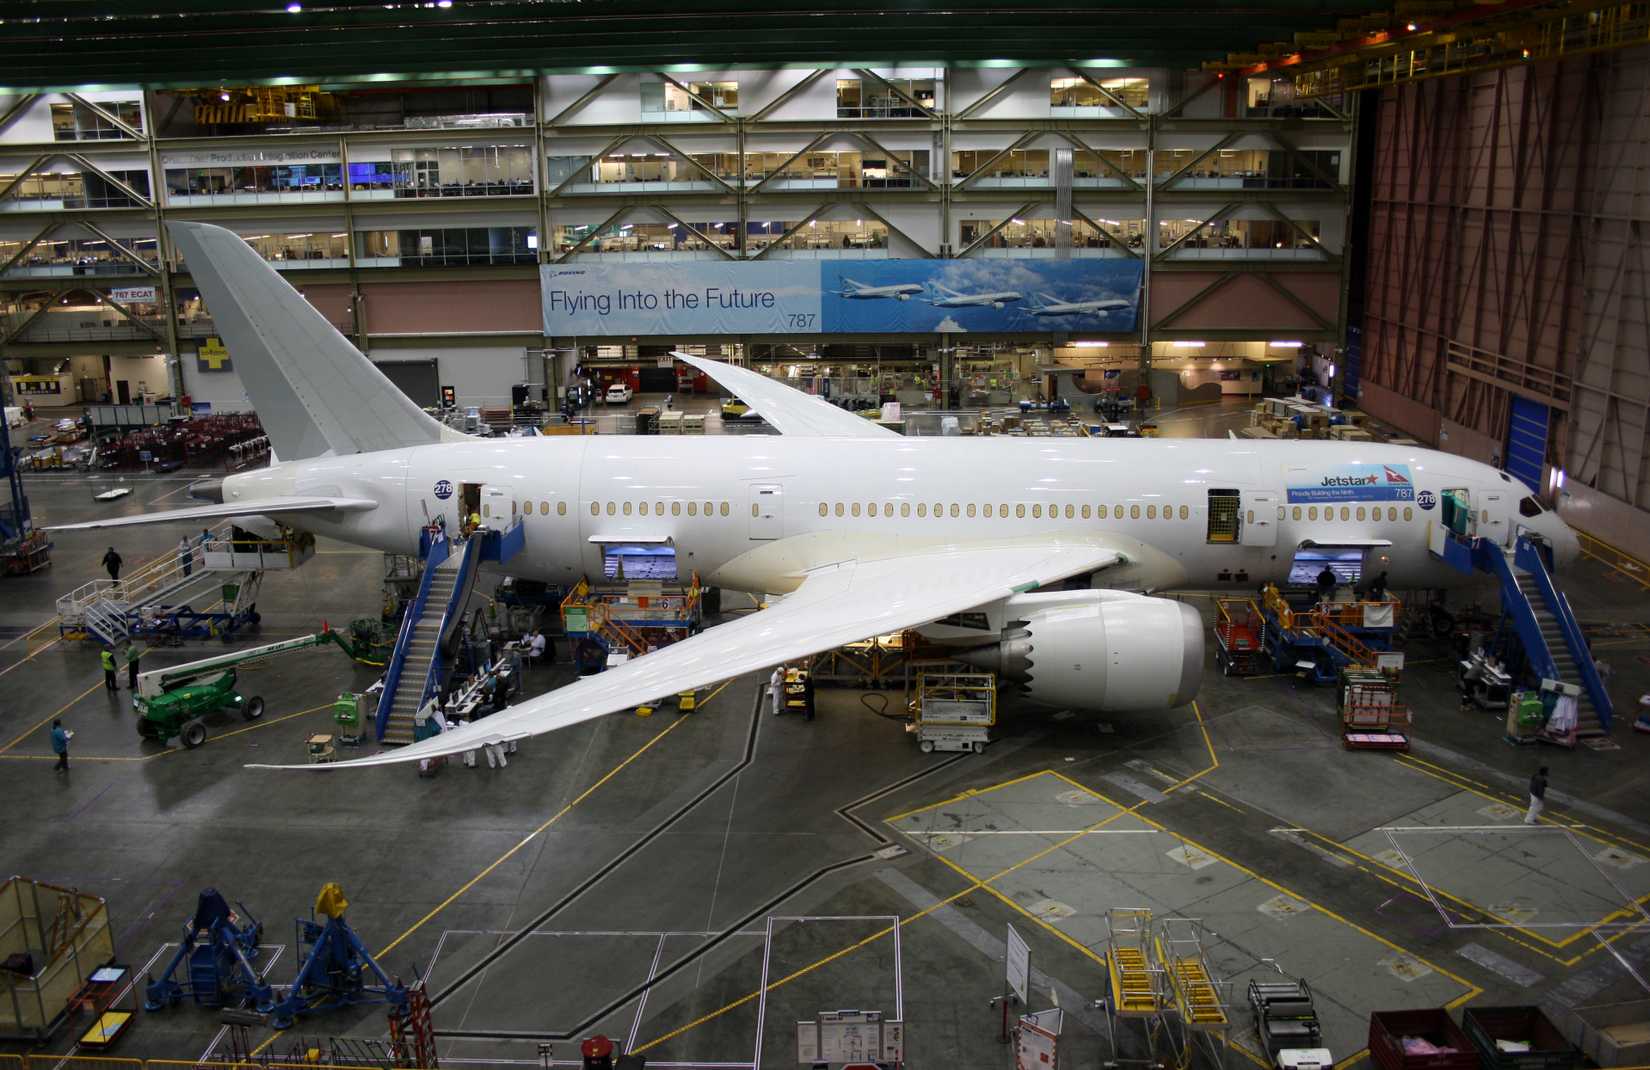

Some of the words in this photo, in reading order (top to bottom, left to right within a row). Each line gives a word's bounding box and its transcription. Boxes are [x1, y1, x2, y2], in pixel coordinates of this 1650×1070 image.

[550, 290, 611, 316] Flying
[618, 289, 658, 310] Into
[663, 289, 699, 310] the
[706, 287, 775, 309] Future
[787, 314, 816, 328] 787
[1321, 475, 1367, 487] Jetstar
[434, 484, 452, 493] 278
[1395, 488, 1413, 498] 787
[1417, 495, 1435, 504] 278
